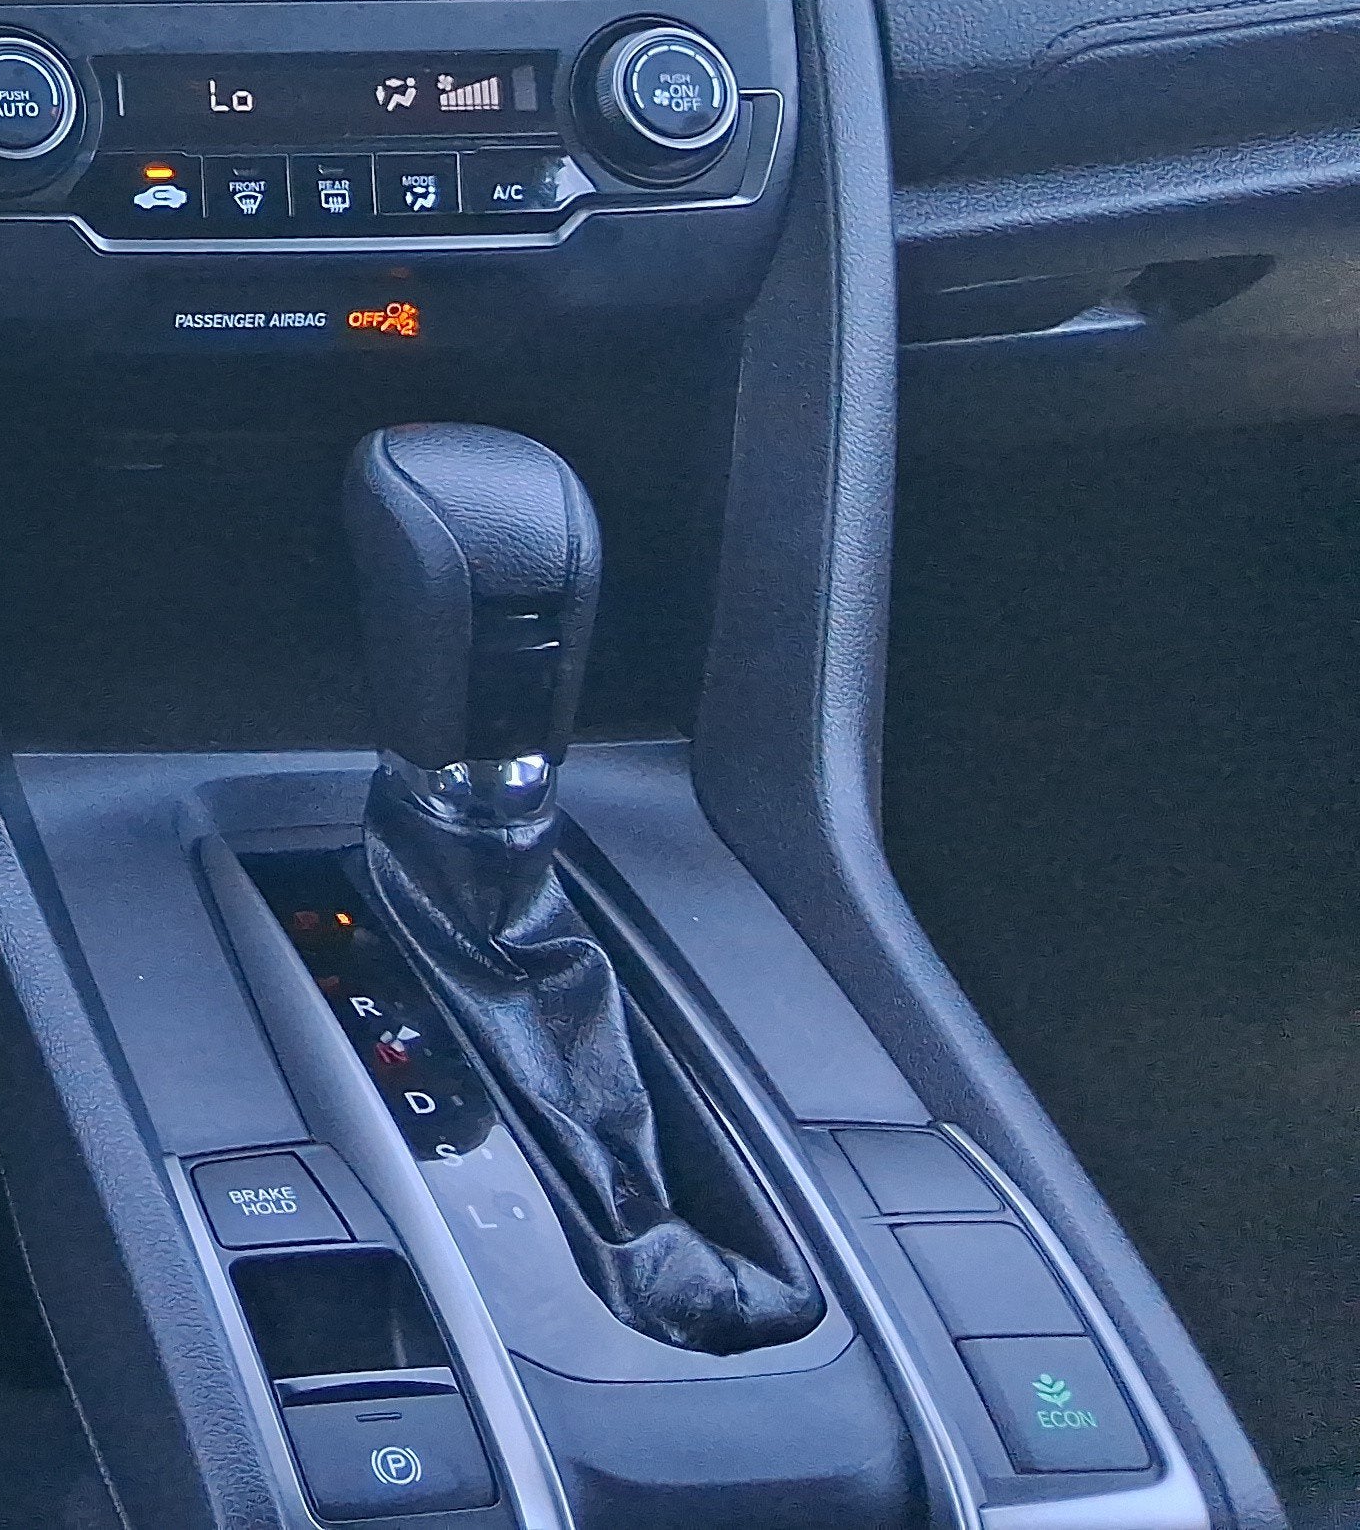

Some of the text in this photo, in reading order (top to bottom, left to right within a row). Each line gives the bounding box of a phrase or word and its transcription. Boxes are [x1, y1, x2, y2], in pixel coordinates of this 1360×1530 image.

[659, 73, 691, 84] PUSH
[671, 97, 702, 112] OFF
[229, 181, 266, 192] FRONT
[318, 180, 350, 192] REAR
[402, 175, 436, 187] MODE
[493, 184, 524, 201] A/C
[174, 312, 327, 329] PASSENGER AIRBAG
[348, 311, 385, 328] OFF
[349, 996, 382, 1018] R
[404, 1090, 437, 1114] D
[435, 1143, 464, 1168] S
[228, 1185, 297, 1205] BRAKE
[241, 1198, 299, 1216] HOLD
[1036, 1410, 1098, 1429] ECON
